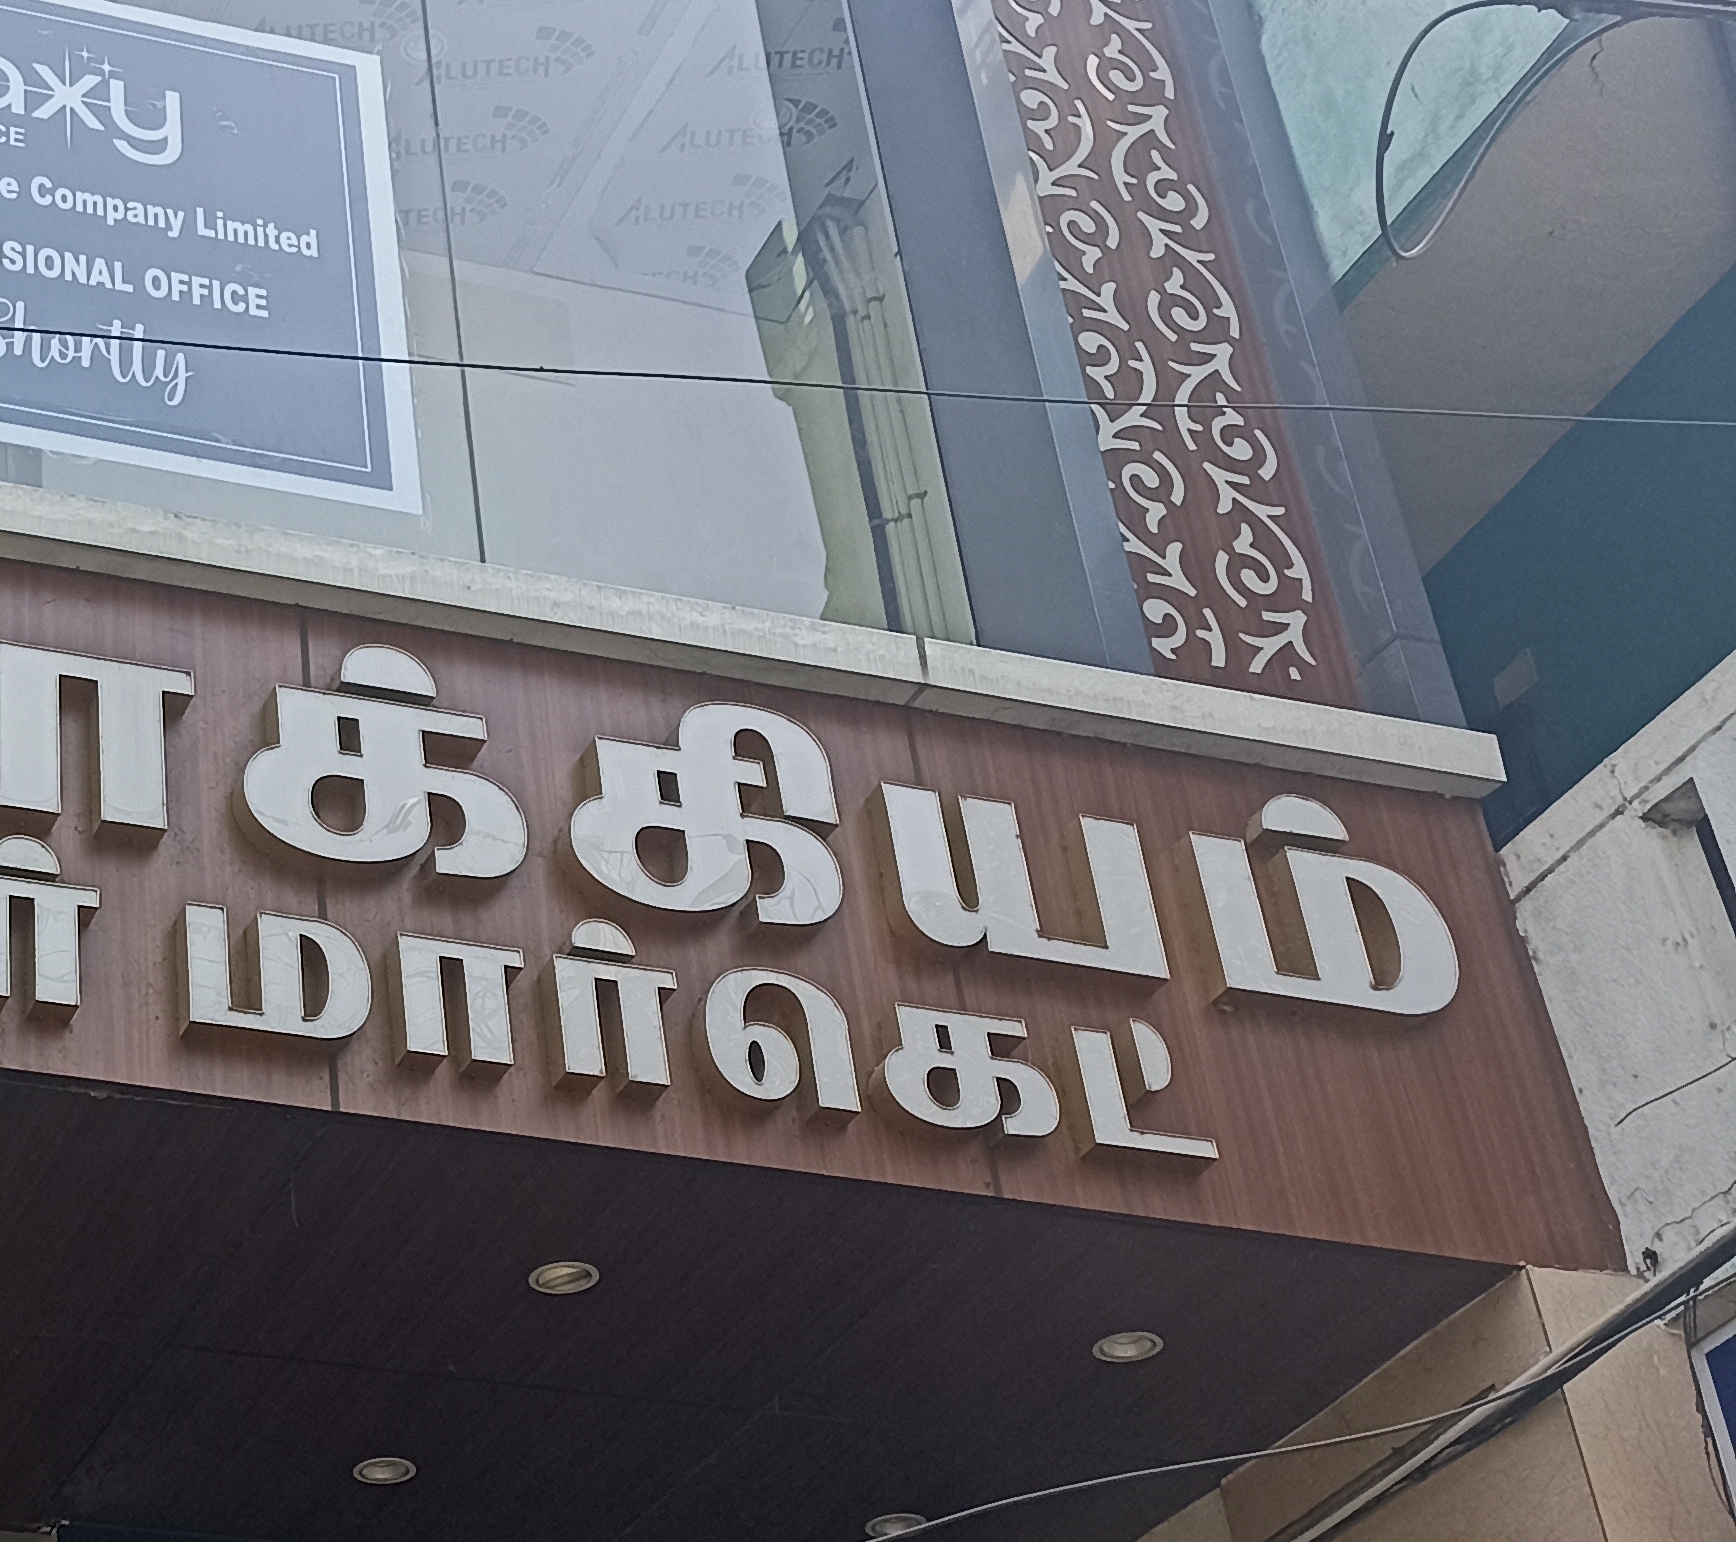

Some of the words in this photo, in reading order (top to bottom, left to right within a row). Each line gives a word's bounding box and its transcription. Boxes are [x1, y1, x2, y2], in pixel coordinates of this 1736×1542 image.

[415, 55, 550, 87] ALUTECH
[706, 42, 845, 77] ALUTECH
[659, 121, 792, 154] ALUTEH
[30, 175, 186, 240] Company
[196, 207, 320, 258] Limited
[615, 195, 746, 227] ALUTECH
[144, 269, 270, 318] OFFICE
[180, 901, 1220, 1162] மார்கெட்
